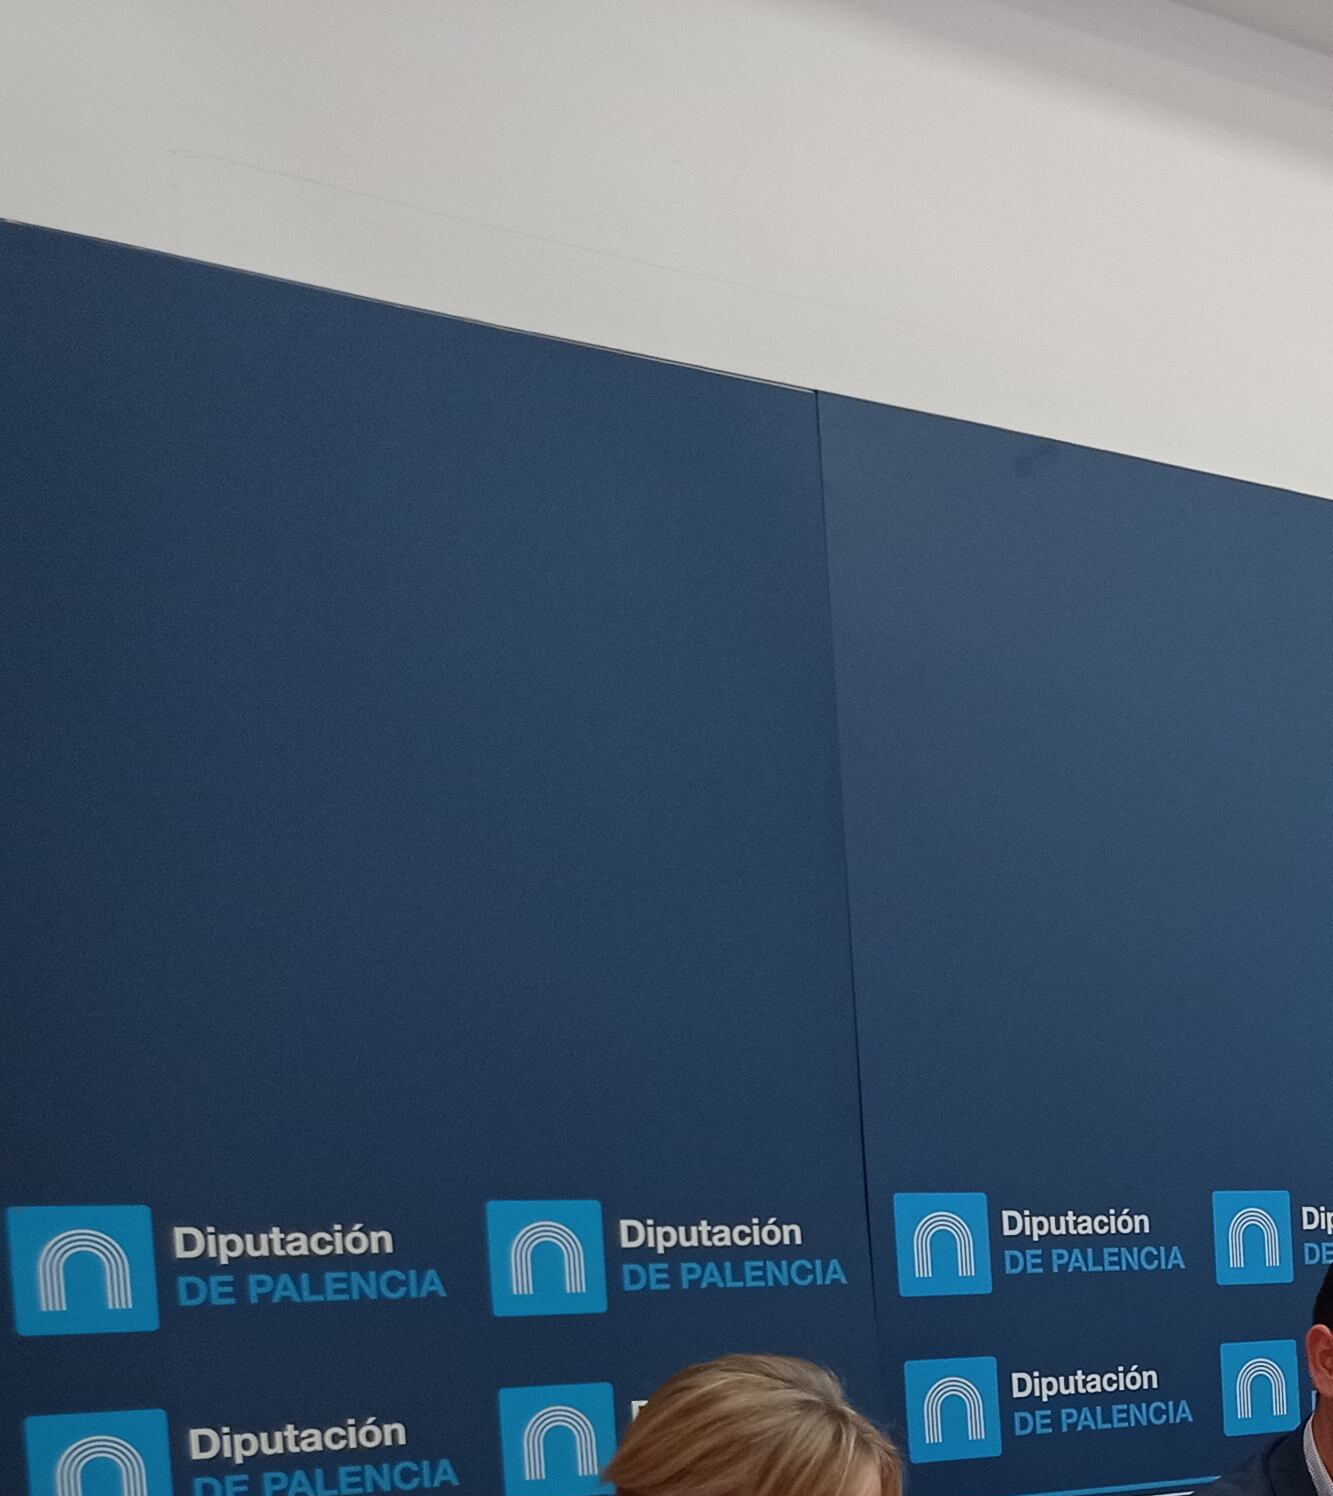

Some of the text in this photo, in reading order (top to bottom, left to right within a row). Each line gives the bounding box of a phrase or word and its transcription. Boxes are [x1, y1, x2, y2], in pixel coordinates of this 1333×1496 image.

[620, 1218, 801, 1253] Diputación
[1002, 1209, 1149, 1241] Diputación
[173, 1223, 393, 1264] Diputación
[1005, 1246, 1185, 1274] DE PALENCIA
[178, 1269, 446, 1306] DE PALENCIA
[623, 1259, 847, 1290] DE PALENCIA
[1012, 1366, 1157, 1401] Diputación
[1014, 1401, 1193, 1435] DE PALENCIA
[189, 1418, 406, 1463] Diputación
